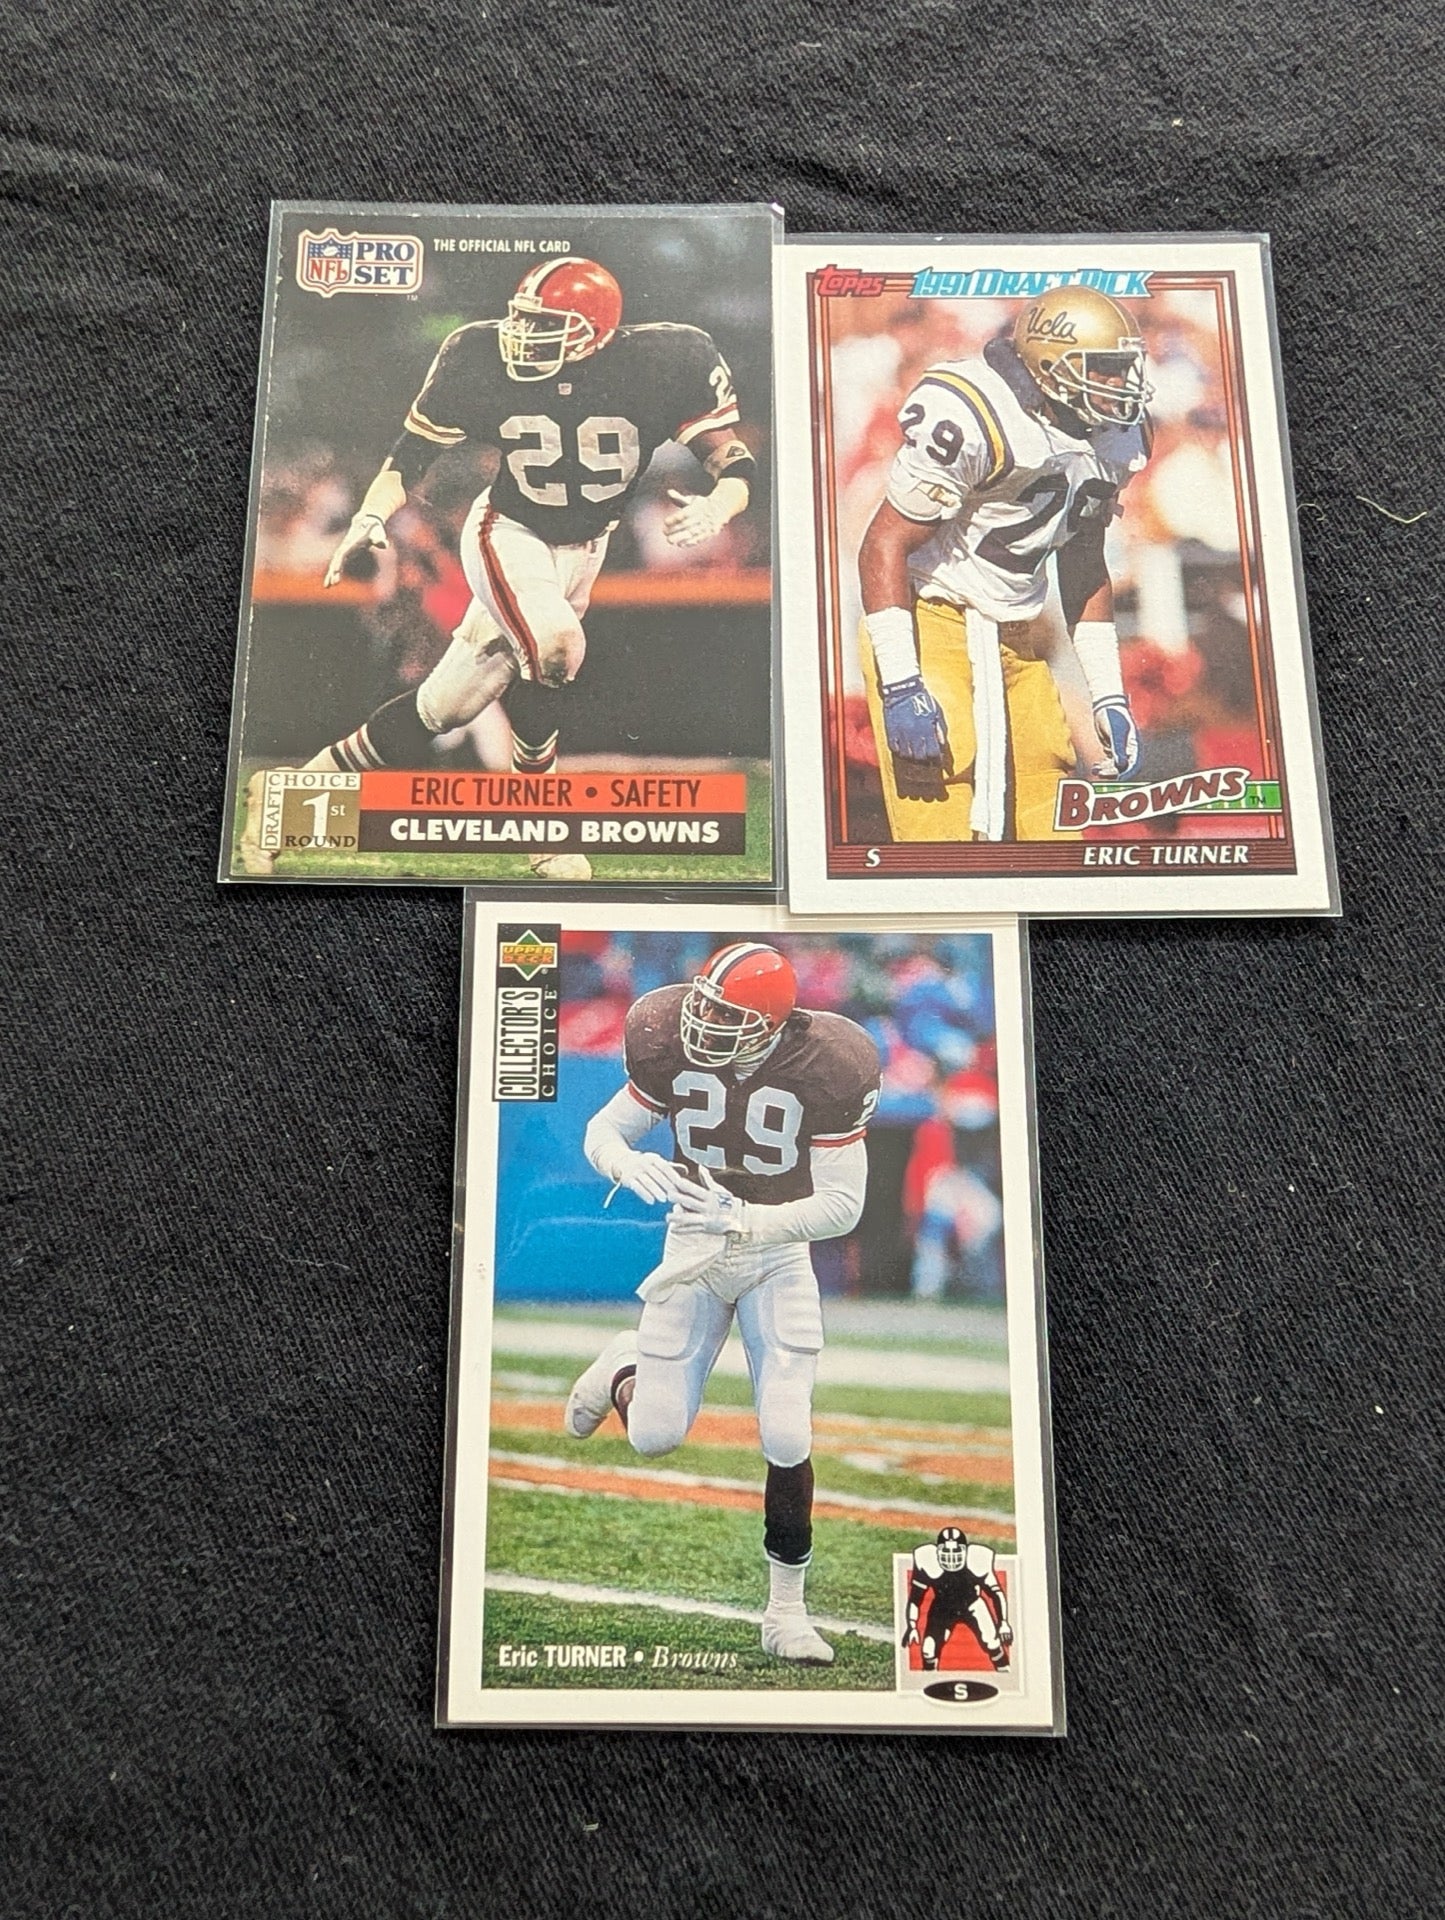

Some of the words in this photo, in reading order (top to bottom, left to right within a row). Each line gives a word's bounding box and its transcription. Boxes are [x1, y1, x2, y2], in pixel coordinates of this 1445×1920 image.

[355, 241, 415, 262] PRO
[433, 239, 456, 251] THE
[459, 239, 511, 252] OFFICIAL
[514, 240, 536, 252] NFL
[539, 240, 571, 253] CARD
[308, 259, 348, 283] NFL
[354, 265, 414, 285] SET
[913, 267, 971, 297] 1991
[1079, 269, 1148, 297] PICK
[900, 403, 965, 467] 29
[499, 414, 640, 507] 29
[268, 773, 358, 787] CHOICE
[410, 777, 466, 806] ERIC
[473, 777, 573, 808] TURNER
[610, 779, 702, 808] SAFETY
[1058, 770, 1245, 828] BROWNS
[264, 787, 281, 847] DRAFT
[285, 835, 356, 848] ROUND
[390, 818, 570, 843] CLEVELAND
[581, 820, 720, 844] BROWNS
[865, 848, 881, 868] S
[1083, 845, 1141, 865] ERIC
[1150, 845, 1250, 865] TURNER
[503, 946, 554, 955] UPPER
[498, 990, 540, 1097] COLLECTOR'S
[541, 990, 558, 1097] CHOICE
[672, 1070, 804, 1176] 29
[499, 1645, 538, 1668] Eric
[543, 1645, 627, 1668] TURNER
[652, 1645, 739, 1669] Browns
[953, 1683, 968, 1700] S
